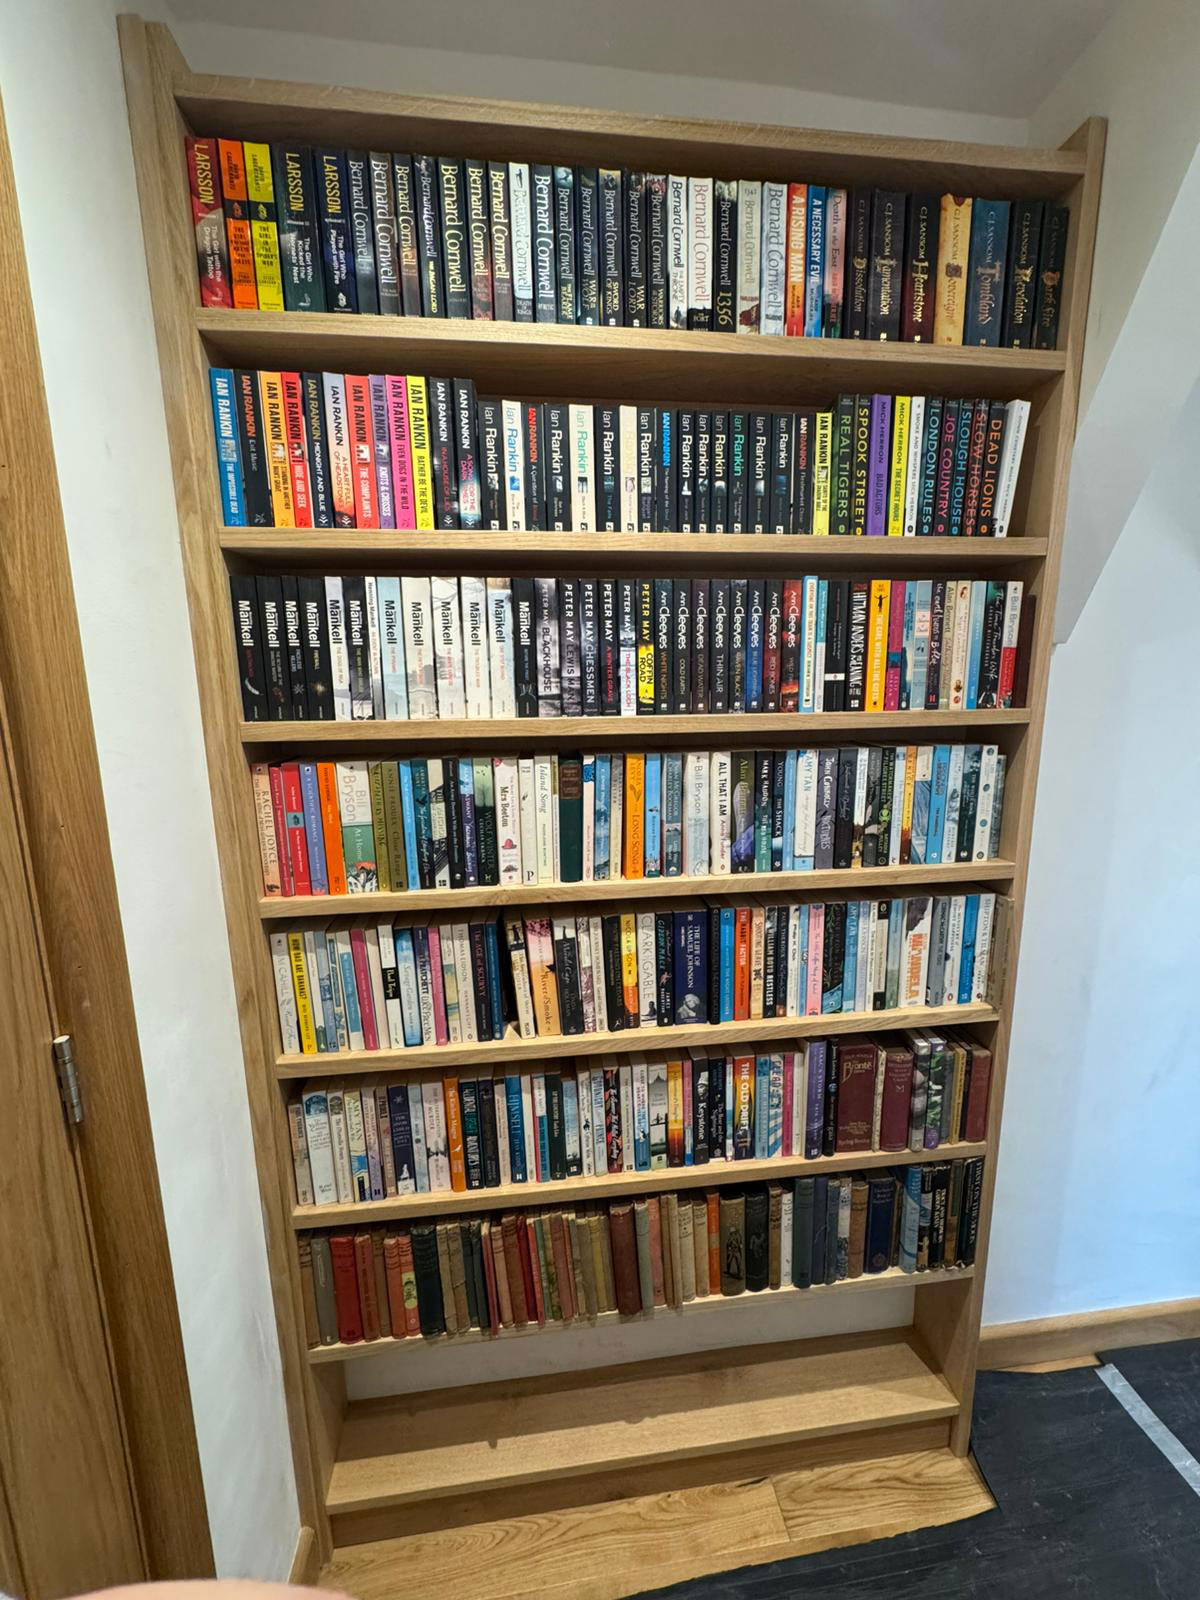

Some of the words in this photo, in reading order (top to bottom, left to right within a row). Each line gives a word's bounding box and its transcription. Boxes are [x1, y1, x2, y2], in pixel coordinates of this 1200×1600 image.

[194, 144, 214, 204] LARSSON
[371, 160, 390, 220] Bernard
[395, 165, 413, 213] Bernard
[441, 164, 463, 226] Bernard
[468, 168, 486, 220] Bernard
[490, 170, 508, 222] Bernard
[534, 174, 554, 234] Bernard
[558, 188, 572, 232] Bernard
[581, 187, 593, 228] Bernard
[604, 190, 617, 230] Bernard
[693, 184, 709, 238] Bernard
[768, 187, 784, 246] Bernard
[204, 227, 212, 254] Dragon
[376, 224, 397, 284] Cornwell
[399, 216, 417, 265] Cornwell
[471, 222, 488, 276] Cornwell
[492, 224, 510, 278] Cornwell
[559, 232, 572, 280] Cornwell
[582, 230, 594, 275] Cornwell
[605, 232, 618, 276] Cornwell
[884, 218, 892, 256] SANSOM
[952, 223, 960, 260] SANSOM
[444, 230, 466, 292] Cornwell
[536, 238, 554, 298] Cornwell
[694, 242, 709, 301] Cornwell
[767, 249, 784, 308] Cornwell
[628, 281, 636, 314] LORD
[637, 285, 645, 310] WAR
[266, 382, 279, 399] IAN
[285, 381, 298, 399] IAN
[352, 385, 365, 402] IAN
[391, 380, 403, 398] IAN
[411, 384, 423, 403] IAN
[437, 382, 446, 401] IAN
[459, 389, 468, 408] IAN
[268, 403, 282, 440] RANKIN
[287, 402, 302, 440] RANKIN
[353, 405, 367, 442] RANKIN
[393, 402, 406, 440] RANKIN
[412, 408, 426, 449] RANKIN
[438, 402, 448, 441] RANKIN
[460, 410, 470, 448] RANKIN
[528, 408, 536, 425] IAN
[603, 410, 612, 428] Ian
[800, 418, 808, 434] IAN
[840, 415, 851, 456] REAL
[857, 408, 869, 463] SPOOK
[944, 415, 955, 442] JOE
[973, 412, 986, 459] SLOW
[314, 441, 323, 476] MIDNIGHT
[529, 425, 538, 462] RANKIN
[603, 431, 614, 474] Rankin
[779, 433, 788, 468] Rankin
[926, 408, 940, 475] LONDON
[956, 411, 971, 470] SLOUGH
[987, 419, 1002, 465] DEAD
[837, 462, 850, 518] TIGERS
[855, 469, 867, 525] STREET
[922, 480, 934, 522] RULES
[938, 448, 952, 518] COUNTRY
[952, 476, 964, 525] HOUSE
[966, 464, 981, 526] HORSES
[981, 470, 996, 517] LIONS
[565, 584, 573, 617] PETER
[584, 584, 593, 617] PETER
[604, 584, 612, 617] PETER
[852, 592, 867, 624] HITMAN
[238, 600, 254, 646] Mankell
[264, 602, 280, 647] Mankell
[285, 600, 300, 646] Mankell
[306, 602, 320, 647] Mankell
[329, 600, 342, 644] Mankell
[349, 600, 363, 645] Mankell
[384, 600, 397, 644] Mankell
[411, 602, 424, 646] Mankell
[441, 601, 453, 645] Mankell
[470, 602, 481, 646] Mankell
[494, 599, 505, 642] Mankell
[519, 602, 530, 645] Mankell
[585, 621, 594, 642] MAY
[604, 620, 613, 642] MAY
[659, 606, 670, 649] Cleeves
[678, 606, 690, 650] Cleeves
[696, 606, 708, 649] Cleeves
[850, 624, 865, 654] ANDERS
[541, 627, 552, 692] BLACKHOUSE
[585, 643, 595, 703] CHESSMEN
[639, 657, 647, 682] ROAD
[539, 764, 550, 790] Island
[694, 765, 703, 780] Bill
[761, 760, 769, 779] MARK
[804, 756, 812, 774] AMY
[804, 776, 812, 792] TAN
[824, 757, 834, 774] JOHN
[261, 790, 274, 830] RACHEL
[341, 775, 357, 821] Bryson
[355, 790, 366, 808] Bill
[500, 786, 509, 802] Mrs
[539, 792, 551, 814] Song
[693, 782, 703, 814] Bryson
[761, 780, 769, 807] HADDON
[822, 776, 833, 808] CONNOLLY
[501, 803, 509, 828] Beeton
[632, 814, 640, 839] LONG
[266, 832, 277, 865] JOYCE
[632, 840, 640, 865] SONG
[624, 920, 633, 944] NICOLA
[641, 915, 654, 954] CLARK
[766, 928, 774, 954] WILLIAM
[625, 947, 634, 968] UPSON
[686, 954, 695, 989] JOHNSON
[694, 957, 701, 965] OF
[766, 956, 774, 974] BOYD
[418, 960, 429, 994] PRATCHETT
[540, 974, 549, 996] River
[641, 960, 654, 1000] GABLE
[765, 975, 774, 1006] RESTLESS
[542, 1000, 553, 1025] Smoke
[741, 1062, 749, 1080] THE
[352, 1097, 360, 1119] AMY
[741, 1082, 749, 1102] OLD
[354, 1122, 362, 1140] TAN
[508, 1094, 520, 1135] HIMSELF
[696, 1102, 706, 1140] Keystone
[740, 1104, 749, 1130] DRIFT
